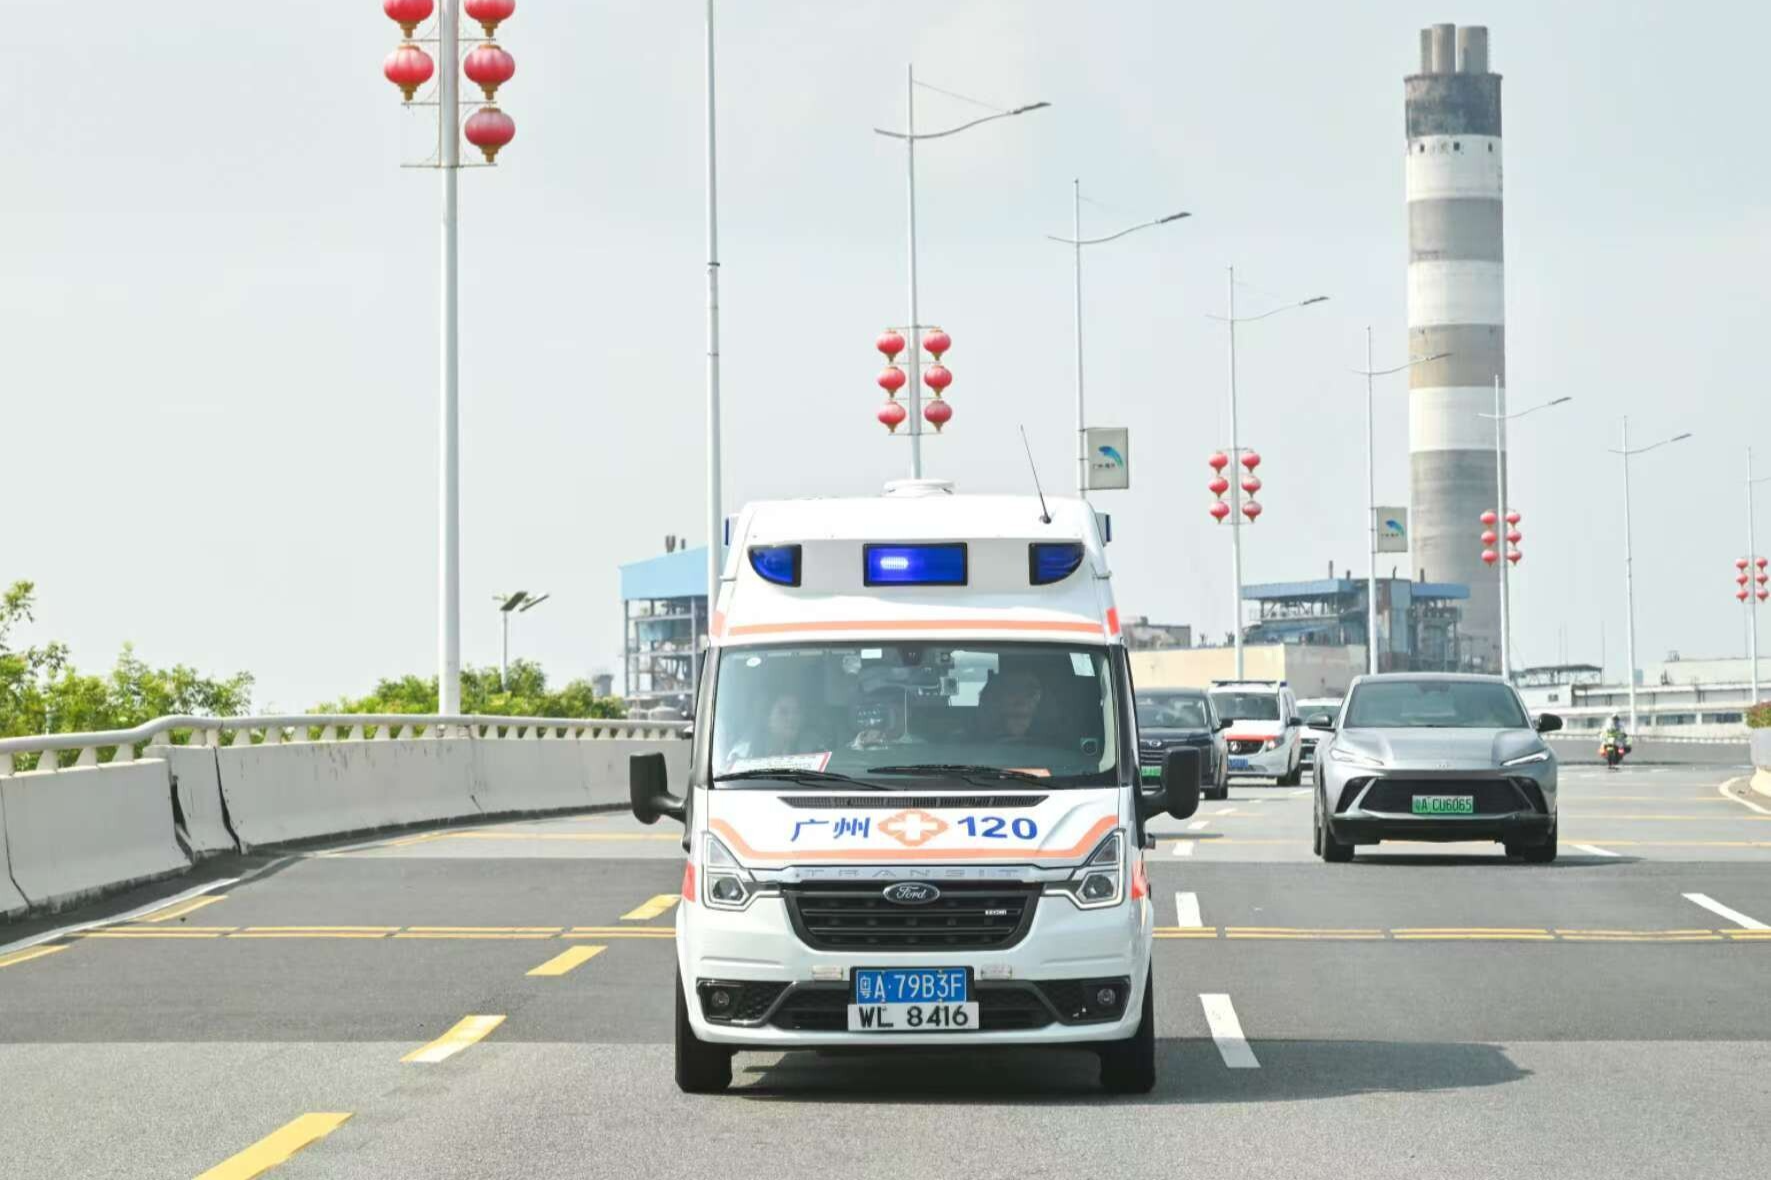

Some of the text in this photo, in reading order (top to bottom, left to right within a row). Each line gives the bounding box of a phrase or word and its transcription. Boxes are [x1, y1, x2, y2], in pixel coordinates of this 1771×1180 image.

[790, 816, 1038, 842] 广州 120
[805, 869, 1020, 878] TRANSIT
[896, 886, 927, 899] Ford
[859, 1005, 968, 1028] WL 8416
